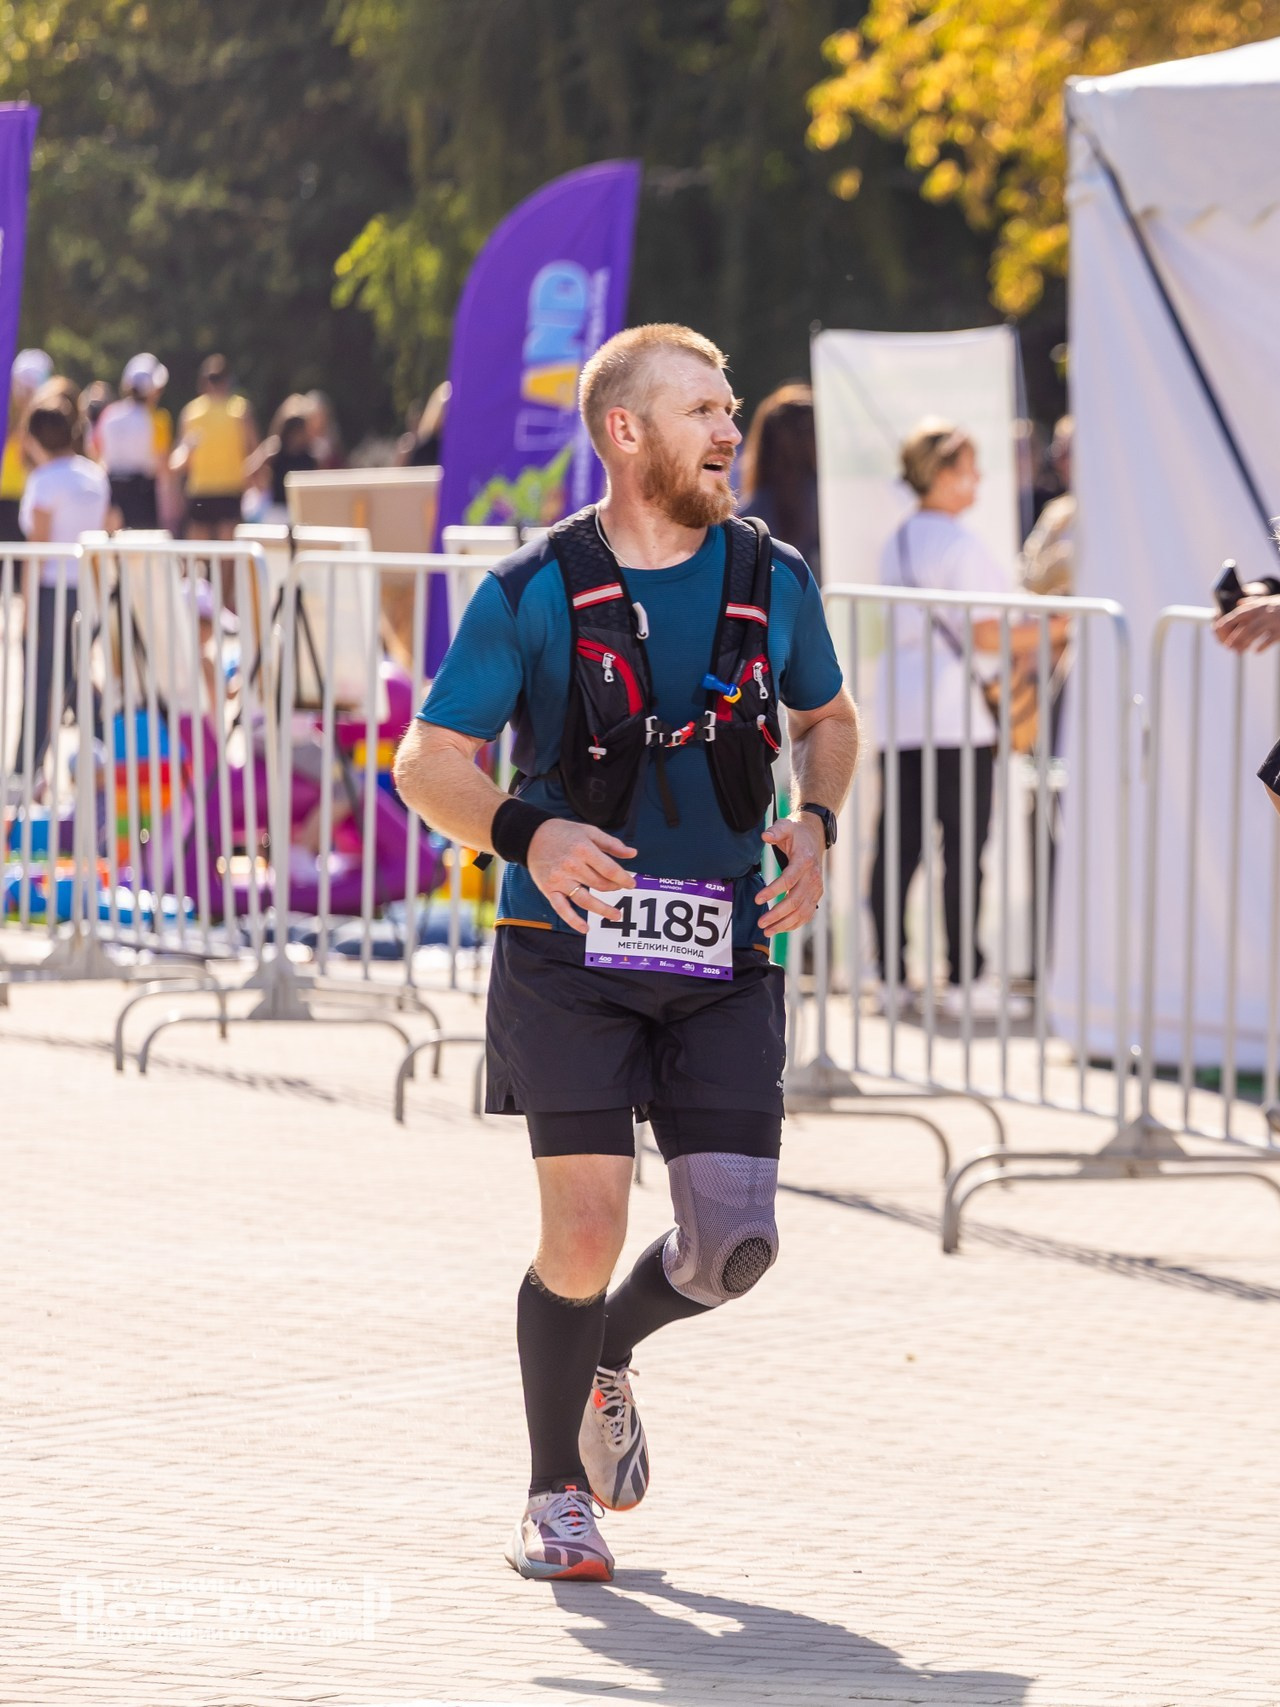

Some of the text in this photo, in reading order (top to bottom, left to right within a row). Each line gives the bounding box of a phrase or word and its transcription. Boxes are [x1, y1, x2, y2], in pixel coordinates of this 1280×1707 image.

[601, 896, 719, 947] 4185
[618, 941, 704, 958] МЕТЁЛКИН ЛЕОНИД
[703, 967, 720, 975] 2026
